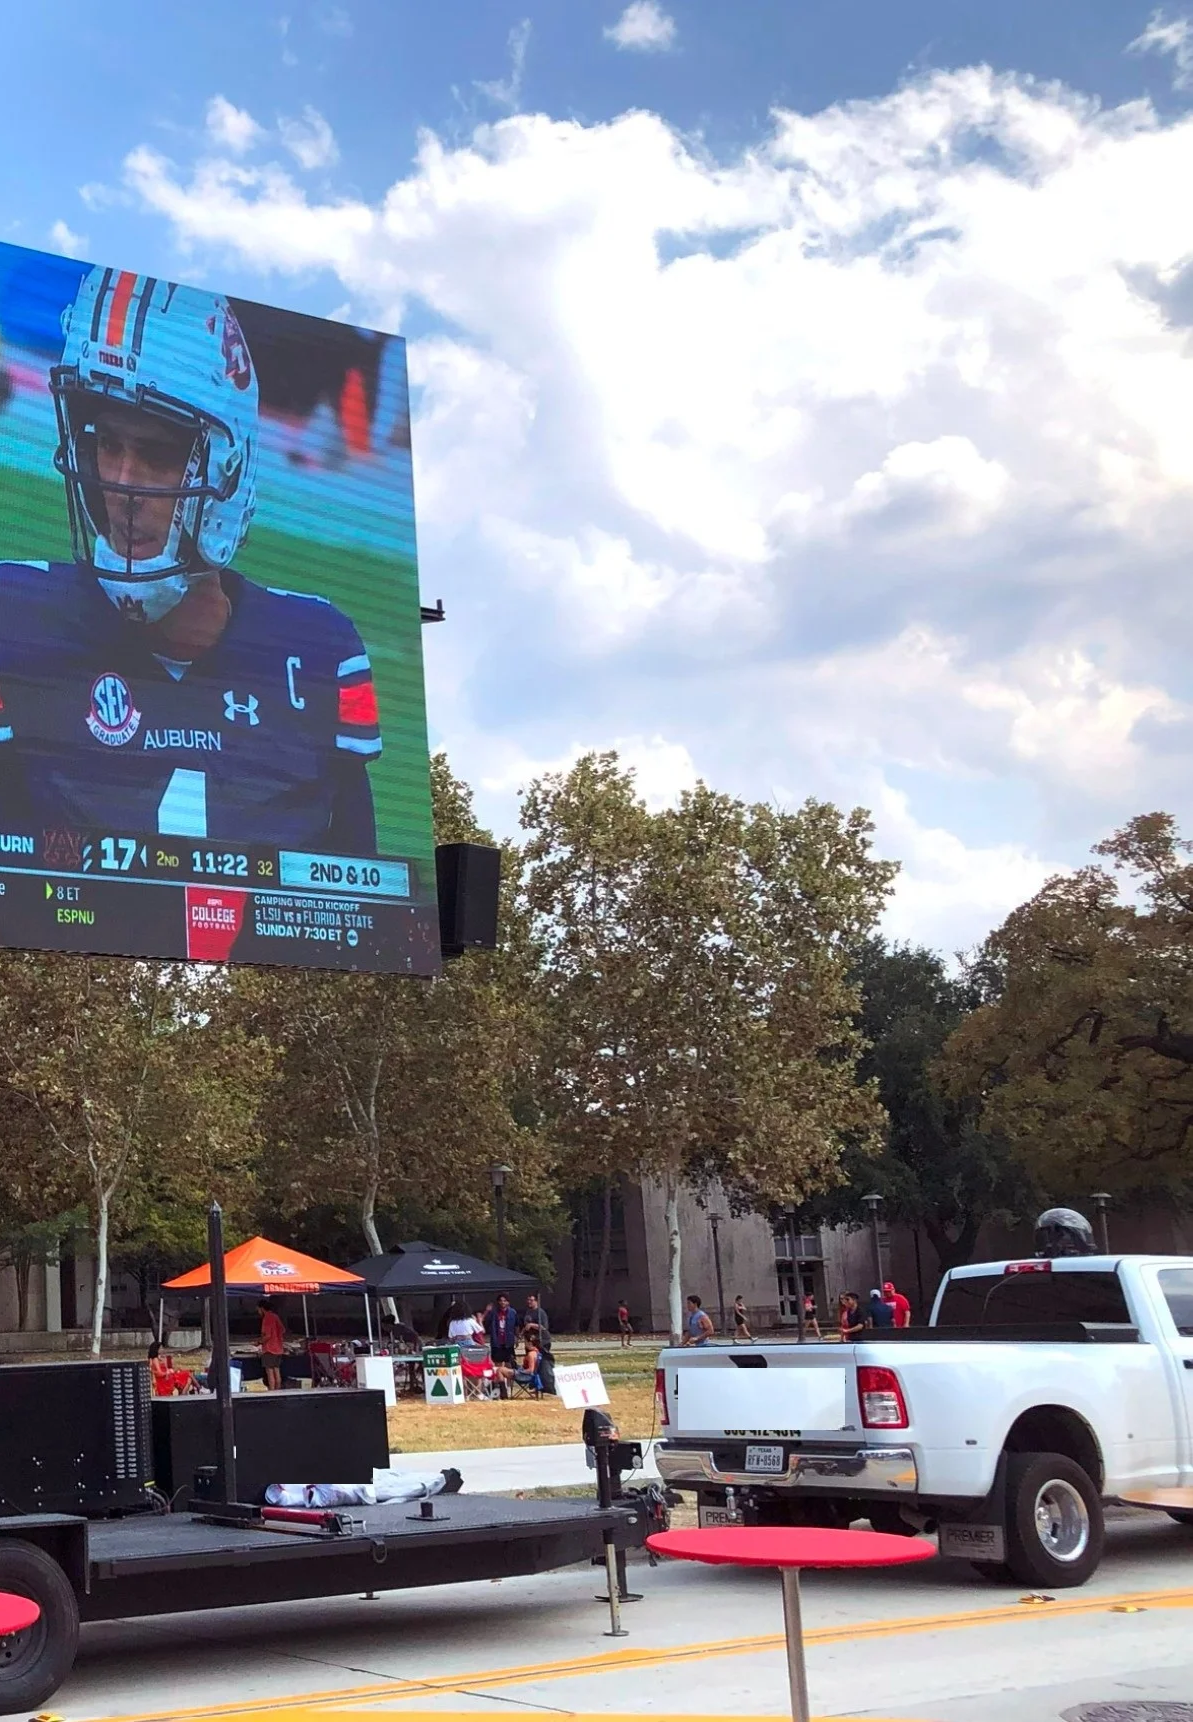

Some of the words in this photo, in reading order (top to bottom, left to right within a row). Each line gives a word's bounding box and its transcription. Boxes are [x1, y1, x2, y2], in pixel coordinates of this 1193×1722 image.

[94, 677, 129, 727] SEC
[93, 722, 136, 745] GRADUATE
[144, 729, 222, 751] AUBURN
[100, 837, 137, 871] 17
[156, 850, 180, 868] 2ND
[192, 850, 248, 876] 11:22
[257, 860, 273, 877] 32
[310, 860, 343, 885] 2ND
[346, 866, 362, 884] &
[363, 866, 380, 888] 10
[57, 885, 65, 900] 8
[66, 886, 81, 901] ET
[254, 895, 293, 907] CAMPING
[294, 898, 324, 909] WORLD
[325, 901, 360, 912] KICKOFF
[57, 908, 95, 925] ESPNU
[192, 906, 235, 923] COLLEGE
[255, 910, 261, 920] 5
[262, 907, 281, 921] LSU
[303, 911, 342, 926] FLORIDA
[345, 914, 374, 929] STATE
[192, 921, 236, 931] FOOTBALL
[255, 922, 301, 938] SUNDAY
[304, 926, 327, 941] 7:30
[328, 928, 342, 941] ET
[557, 1370, 600, 1384] HOUSTON
